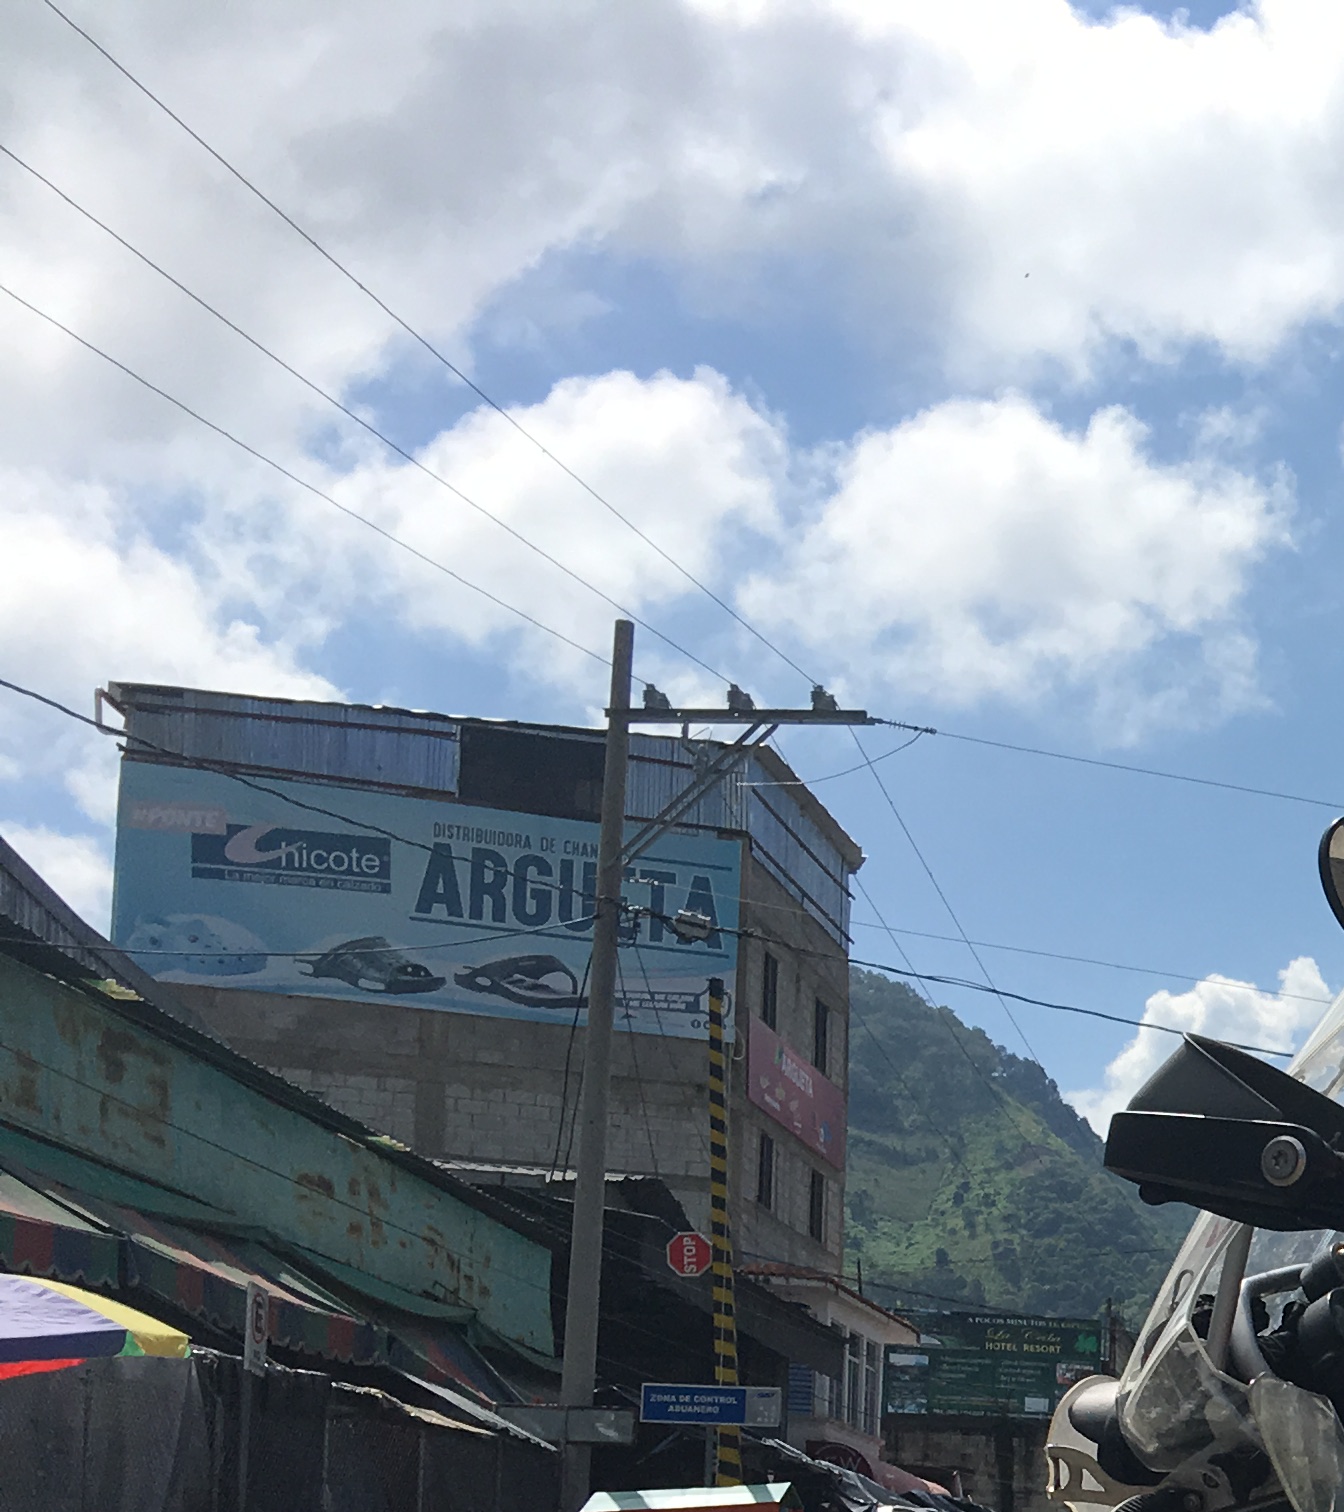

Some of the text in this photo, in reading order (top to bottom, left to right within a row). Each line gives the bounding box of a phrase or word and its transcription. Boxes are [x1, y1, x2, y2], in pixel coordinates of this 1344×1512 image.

[225, 825, 381, 875] Chicote
[433, 821, 533, 851] DISTRIBUIDORA
[540, 836, 556, 854] DE
[682, 1236, 697, 1274] STOP
[985, 1341, 1062, 1355] HOTEL RESORT
[649, 1394, 738, 1405] ZONA DE CONTROL
